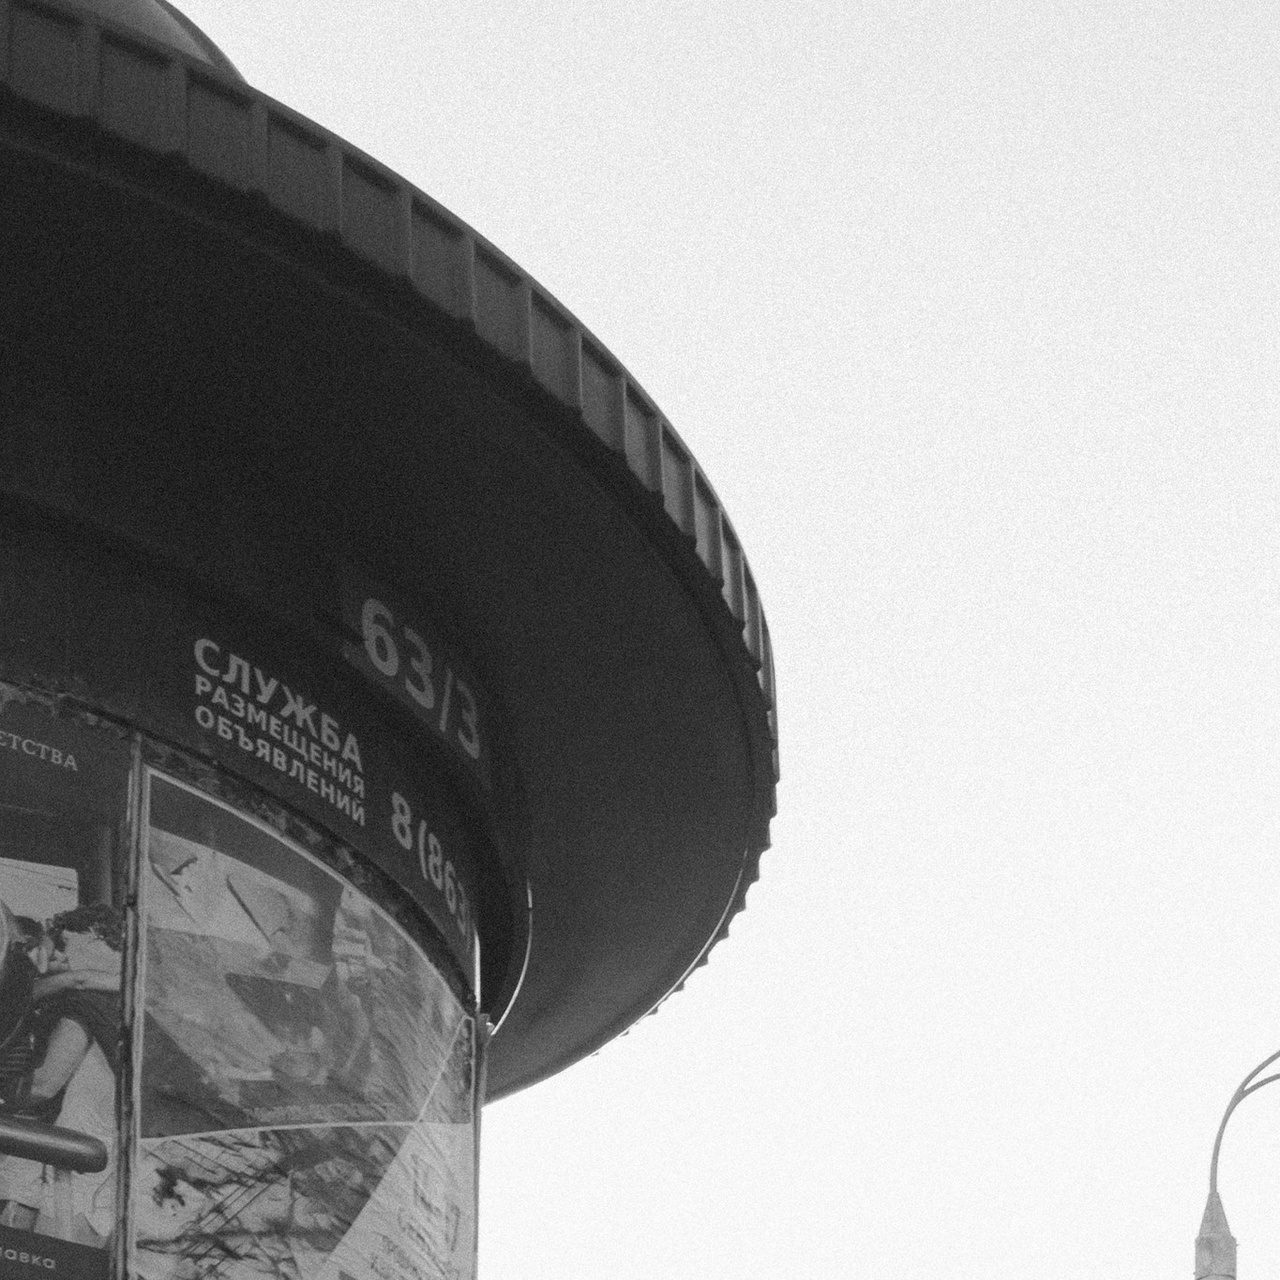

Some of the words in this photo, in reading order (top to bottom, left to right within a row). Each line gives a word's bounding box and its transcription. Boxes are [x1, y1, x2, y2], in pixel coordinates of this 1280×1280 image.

[193, 637, 365, 772] СЛУЖБА
[194, 673, 366, 799] РАЗМЕЩЕНИЯ
[361, 598, 480, 760] 63/3
[193, 704, 366, 827] ОБЪЯВЛЕНИЙ
[0, 1246, 56, 1270] авка
